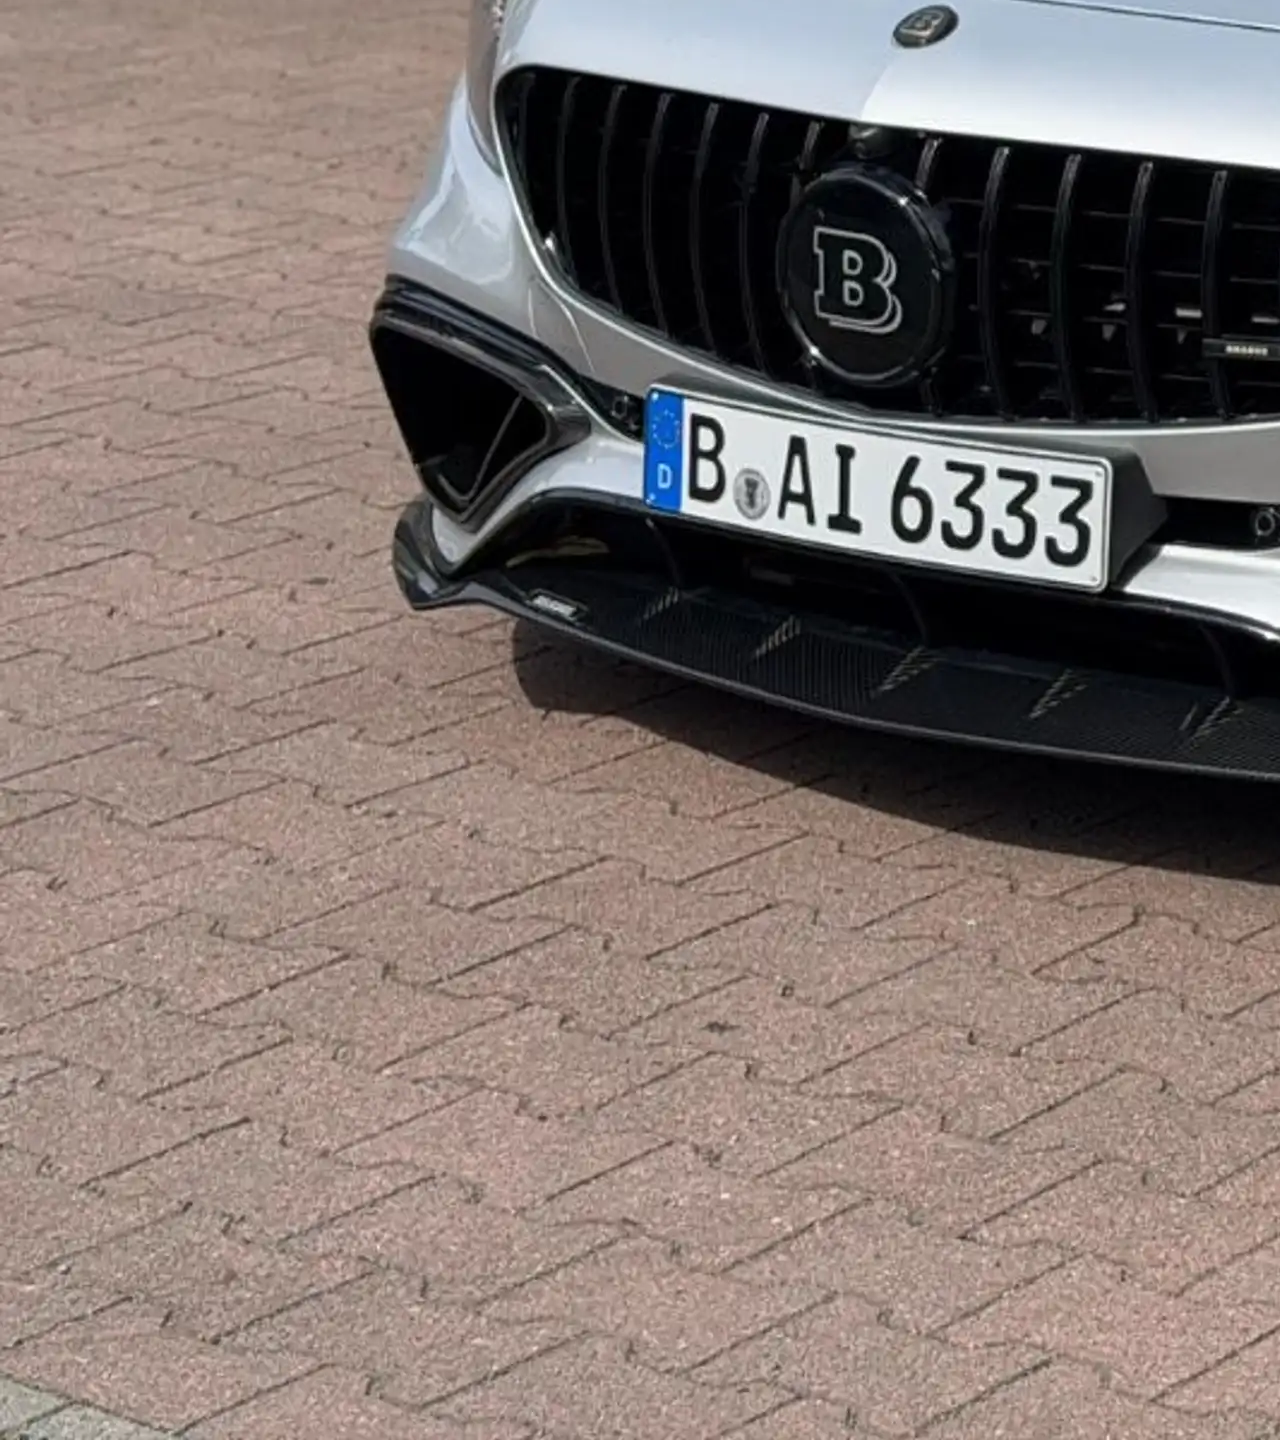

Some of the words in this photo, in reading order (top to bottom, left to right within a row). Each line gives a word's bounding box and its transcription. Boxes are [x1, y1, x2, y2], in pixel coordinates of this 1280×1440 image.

[812, 226, 902, 334] B
[657, 463, 673, 489] D
[688, 413, 726, 503] B
[777, 435, 862, 535] AI
[891, 456, 1093, 568] 6333
